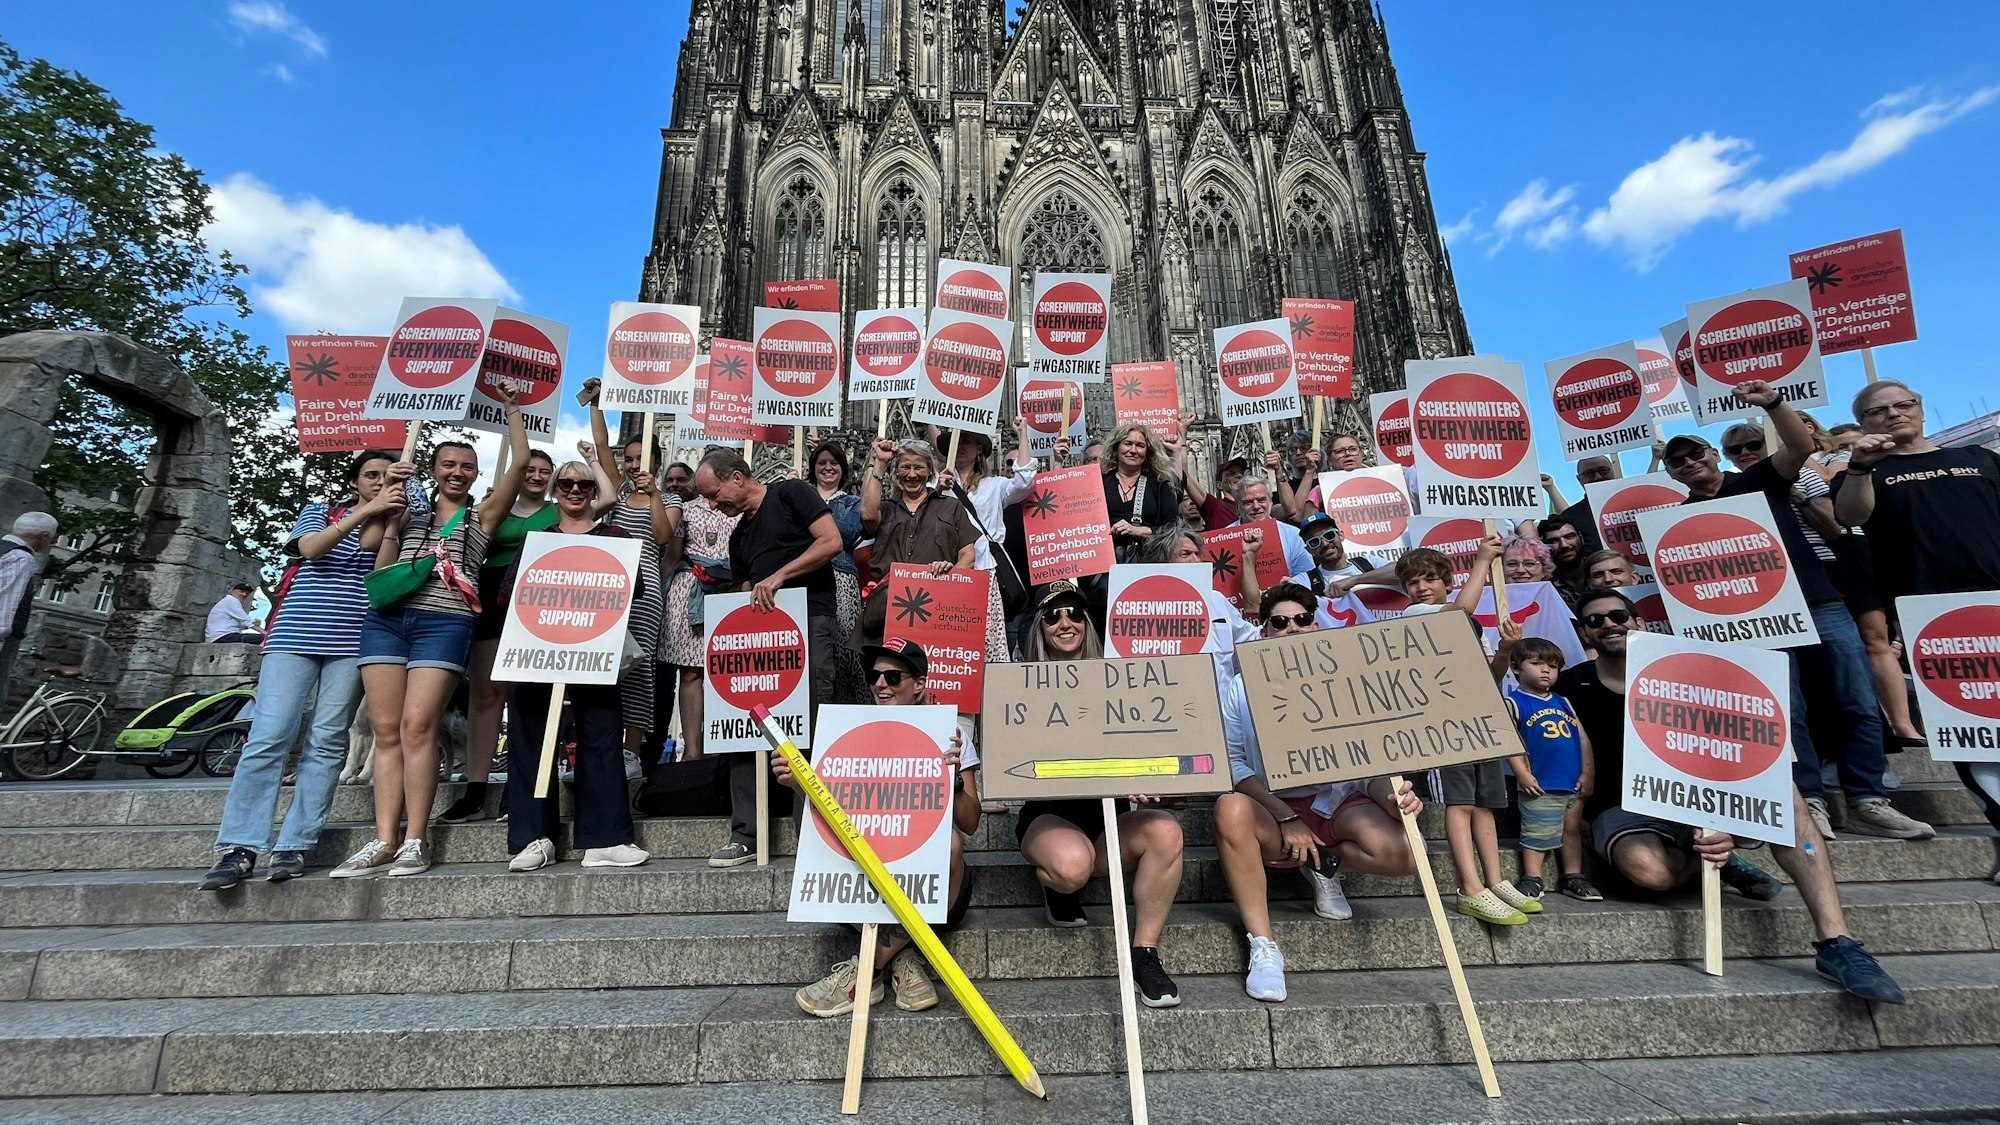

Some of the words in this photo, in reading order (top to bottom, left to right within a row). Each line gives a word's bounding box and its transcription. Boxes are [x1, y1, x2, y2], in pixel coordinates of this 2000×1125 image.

[1794, 255, 1810, 264] Wir
[1813, 244, 1855, 260] erfinden
[1857, 238, 1883, 250] Film.
[944, 285, 1003, 301] SCREENWRITERS
[1840, 292, 1907, 312] Verträge
[941, 296, 1005, 315] EVERYWHERE
[1039, 302, 1103, 314] SCREENWRITERS
[1036, 315, 1104, 329] EVERYWHERE
[1827, 305, 1906, 326] Drehbuch-
[399, 328, 481, 341] SCREENWRITERS
[615, 331, 690, 343] SCREENWRITERS
[860, 331, 917, 342] SCREENWRITERS
[1050, 331, 1086, 343] SUPPORT
[1699, 314, 1803, 346] SCREENWRITERS
[390, 343, 479, 358] EVERYWHERE
[486, 337, 557, 365] REENWRITERS
[611, 343, 692, 360] EVERYWHERE
[761, 338, 832, 353] SCREENWRITERS
[856, 342, 918, 355] EVERYWHERE
[932, 338, 1002, 362] SCREENWRITERS
[1222, 344, 1286, 363] SCREENWRITERS
[1701, 328, 1809, 365] EVERYWHERE
[758, 352, 834, 370] EVERYWHERE
[869, 356, 902, 366] SUPPORT
[927, 351, 1002, 379] EVERYWHERE
[1309, 351, 1349, 363] Verträge
[1725, 353, 1783, 375] SUPPORT
[405, 361, 453, 374] SUPPORT
[483, 353, 558, 384] ERYWHERE
[628, 361, 671, 372] SUPPORT
[1033, 359, 1100, 375] #WGASTRIKE
[1222, 357, 1290, 377] EVERYWHERE
[1299, 362, 1348, 372] Drehbuch-
[776, 371, 816, 384] SUPPORT
[853, 379, 915, 393] #WGASTRIKE
[941, 372, 981, 389] SUPPORT
[1238, 373, 1274, 387] SUPPORT
[1556, 370, 1633, 397] SCREENWRITERS
[300, 400, 335, 408] Faire
[338, 399, 367, 408] Vert
[373, 393, 465, 411] #WGASTRIKE
[606, 388, 688, 405] #WGASTRIKE
[711, 390, 737, 401] Faire
[1558, 381, 1640, 413] EVERYWHERE
[710, 402, 725, 410] für
[758, 400, 834, 417] #WGASTRIKE
[918, 399, 993, 426] #WGASTRIKE
[1141, 408, 1177, 416] Verträge
[1227, 396, 1295, 418] #WGASTRIKE
[1418, 401, 1520, 418] SCREENWRITERS
[1577, 402, 1622, 421] SUPPORT
[300, 412, 320, 422] für
[708, 425, 756, 436] weltweit.
[1418, 420, 1528, 441] EVERYWHERE
[1567, 424, 1650, 453] #WGASTRIKE
[304, 437, 367, 447] weltweit.
[1445, 443, 1503, 460] SUPPORT
[1036, 474, 1067, 484] erfinden
[1068, 470, 1087, 479] Film.
[1885, 469, 1948, 486] CAMERA
[1065, 497, 1102, 509] drehbuch
[1330, 492, 1402, 509] SCREENWRITERS
[1427, 484, 1538, 507] #WGASTRIKE
[1331, 504, 1408, 523] EVERYWHERE
[1029, 533, 1056, 544] Faire
[1058, 522, 1106, 539] Verträge
[1210, 531, 1243, 543] erfinden
[1351, 521, 1392, 535] SUPPORT
[1030, 545, 1046, 556] für
[1048, 537, 1106, 552] Drehbuch-
[1659, 533, 1772, 564] SCREENWRITERS
[894, 569, 910, 578] Wir
[952, 573, 973, 583] Film.
[1033, 565, 1082, 580] weltweit.
[1661, 550, 1785, 586] EVERYWHERE
[527, 569, 625, 589] SCREENWRITERS
[1694, 576, 1760, 601] SUPPORT
[518, 586, 626, 611] EVERYWHERE
[935, 603, 976, 614] deutscher
[1116, 601, 1203, 616] SCREENWRITERS
[538, 610, 596, 627] SUPPORT
[939, 613, 982, 623] drehbuch
[934, 623, 968, 632] verband
[1112, 618, 1205, 637] EVERYWHERE
[1683, 613, 1808, 642] #WGASTRIKE
[712, 630, 798, 651] SCREENWRITERS
[1132, 639, 1182, 655] SUPPORT
[502, 648, 614, 672] #WGASTRIKE
[923, 644, 980, 661] Verträge
[1254, 639, 1339, 682] THIS
[1358, 621, 1453, 666] DEAL
[709, 649, 802, 675] EVERYWHERE
[1020, 664, 1080, 689] THIS
[1104, 659, 1178, 689] DEAL
[731, 674, 780, 693] SUPPORT
[1300, 668, 1430, 724] STINKS
[1638, 677, 1774, 717] SCREENWRITERS
[1005, 702, 1028, 726] IS
[1045, 702, 1070, 728] A
[1526, 708, 1556, 727] GOLDEN
[1634, 698, 1781, 747] EVERYWHERE
[1540, 720, 1571, 739] 30
[1345, 740, 1372, 767] IN
[1383, 714, 1502, 762] COLOGNE
[1666, 731, 1743, 763] SUPPORT
[822, 757, 942, 778] SCREENWRITERS
[1632, 774, 1783, 828] #WGASTRIKE
[831, 807, 840, 815] A
